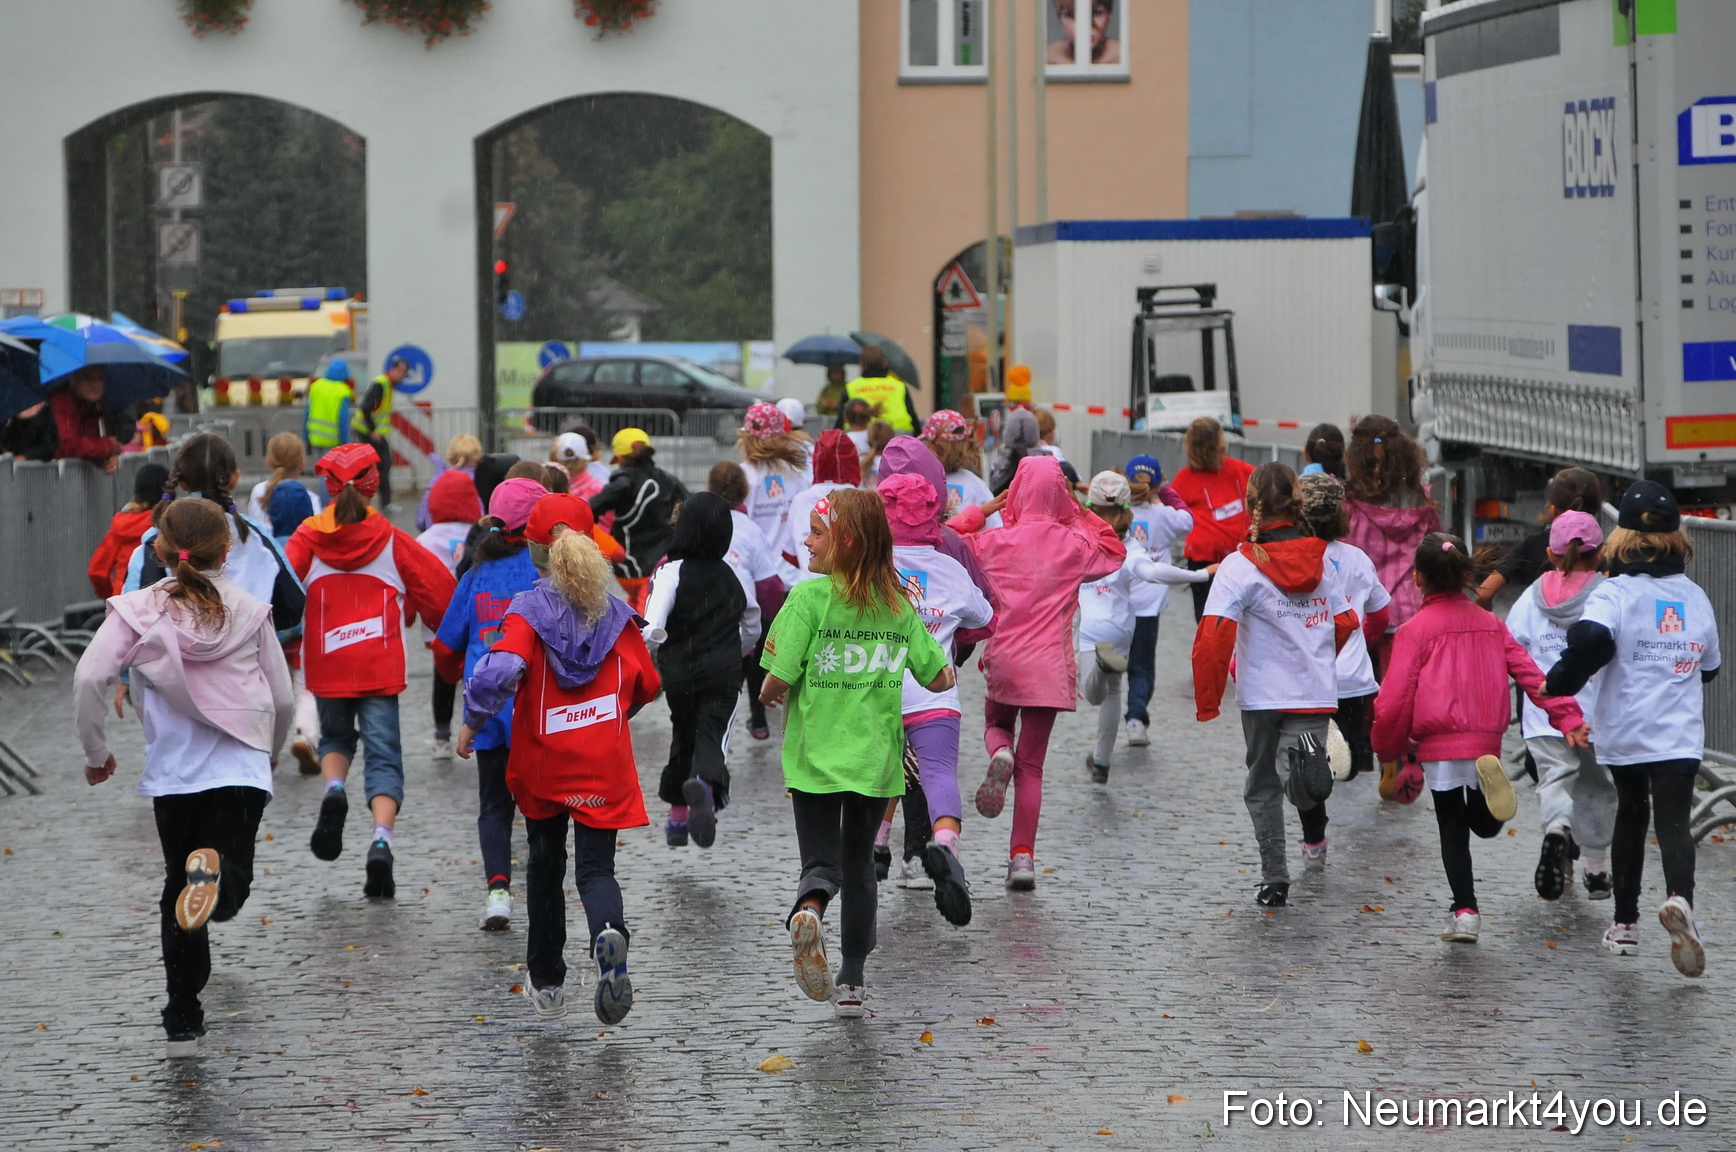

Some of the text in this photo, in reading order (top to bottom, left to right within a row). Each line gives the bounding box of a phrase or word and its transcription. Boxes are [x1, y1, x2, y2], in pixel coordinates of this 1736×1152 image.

[1563, 99, 1617, 197] BOCK
[1312, 597, 1327, 607] TV
[930, 607, 945, 618] TV
[1306, 610, 1329, 628] 2011
[340, 626, 366, 641] DEHN
[1637, 639, 1705, 653] neumarkt TV
[844, 643, 909, 673] DAV
[809, 679, 839, 689] Sektion
[566, 706, 597, 723] DEHN
